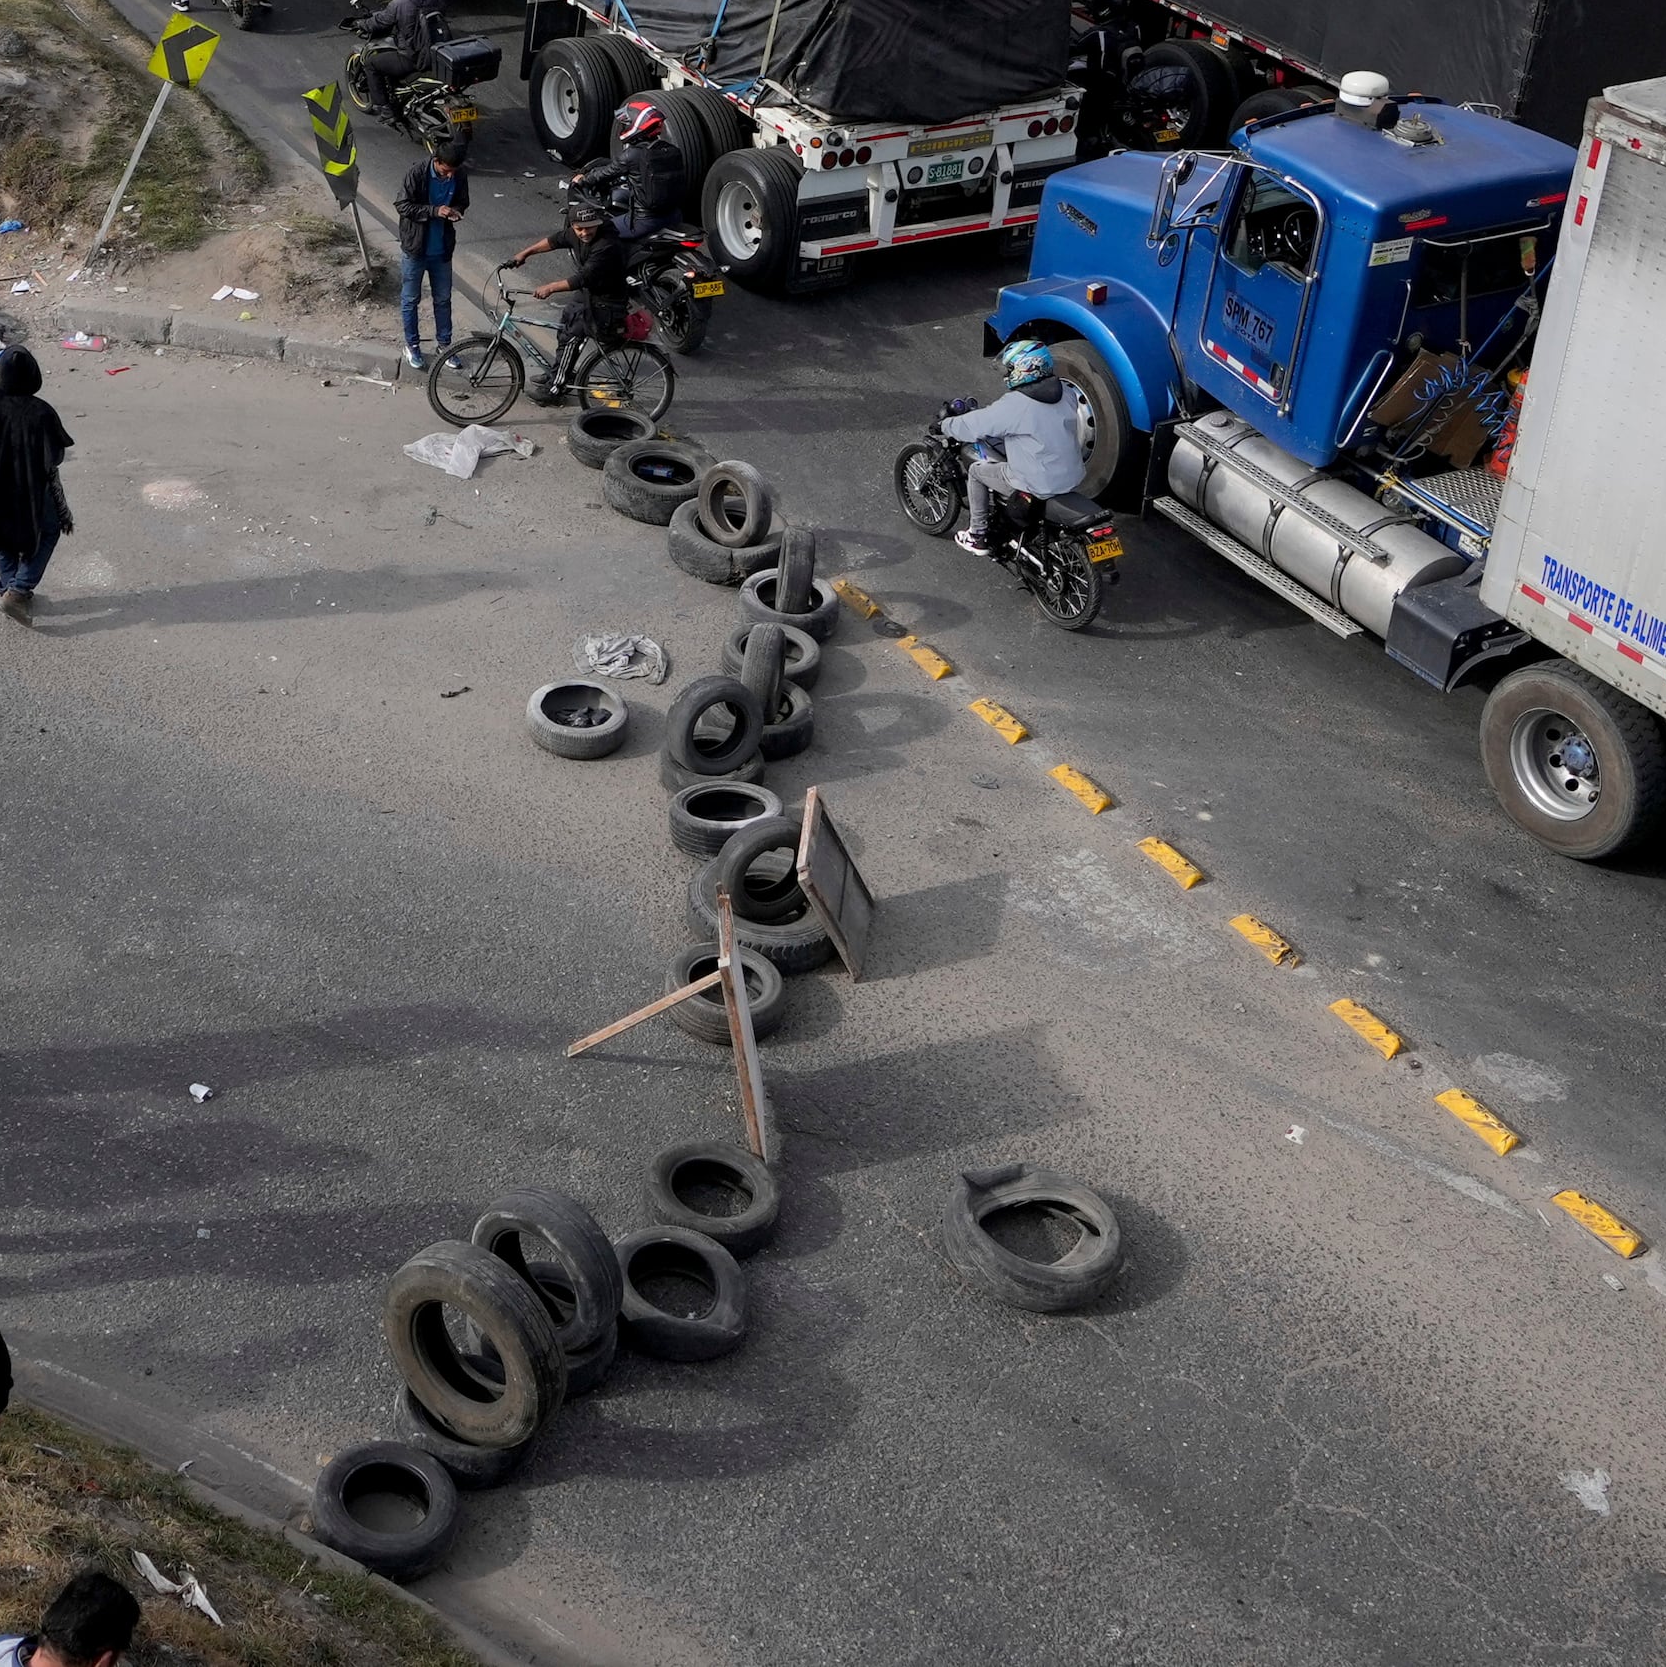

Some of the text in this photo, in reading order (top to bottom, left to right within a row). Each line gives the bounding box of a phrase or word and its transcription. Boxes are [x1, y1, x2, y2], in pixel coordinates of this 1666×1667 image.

[802, 210, 857, 225] romarco
[1225, 297, 1274, 345] SPM 767
[1541, 554, 1616, 623] TRANSPORTE
[1613, 597, 1634, 634] DE
